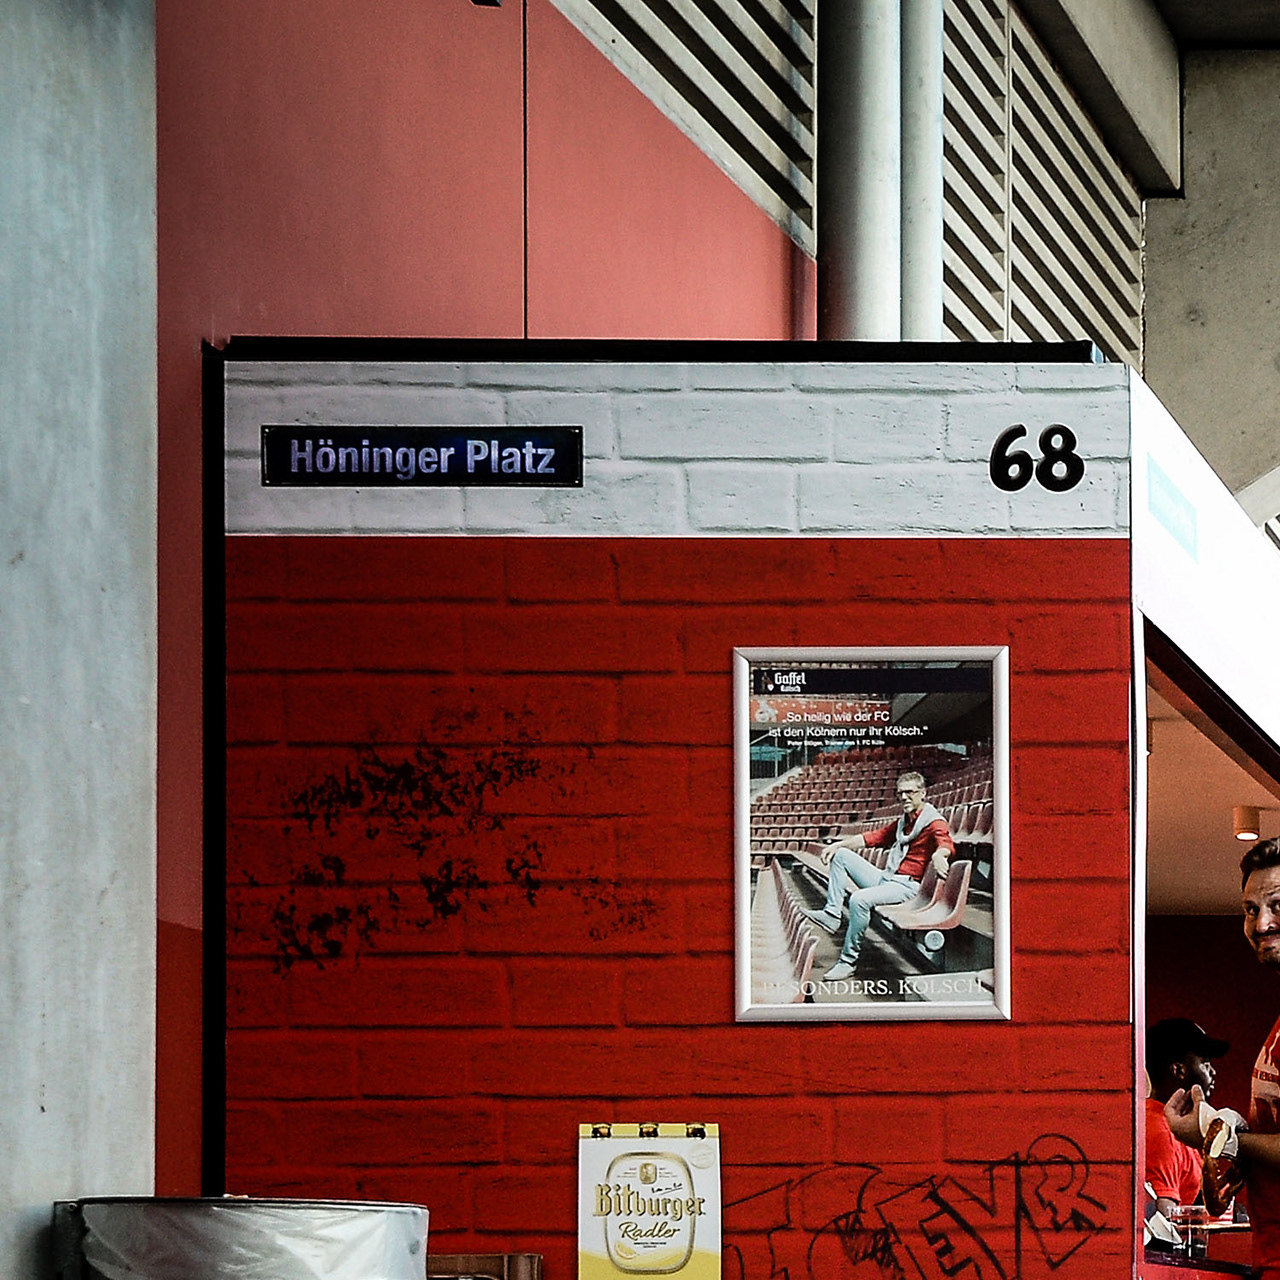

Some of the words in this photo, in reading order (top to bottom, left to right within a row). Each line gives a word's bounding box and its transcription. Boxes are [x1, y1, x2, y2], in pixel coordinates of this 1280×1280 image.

[291, 439, 455, 480] Höninger
[467, 440, 556, 474] Platz
[989, 423, 1085, 493] 68
[774, 672, 807, 685] Gaffel
[803, 710, 832, 724] heilig
[833, 712, 852, 722] wie
[854, 710, 873, 722] der
[874, 710, 890, 721] FC
[769, 726, 782, 737] ist
[783, 726, 804, 737] den
[806, 726, 847, 737] Kölnern
[849, 728, 866, 737] nur
[868, 725, 883, 736] ihr
[593, 1183, 706, 1221] Bitburger
[618, 1221, 681, 1241] Radler
